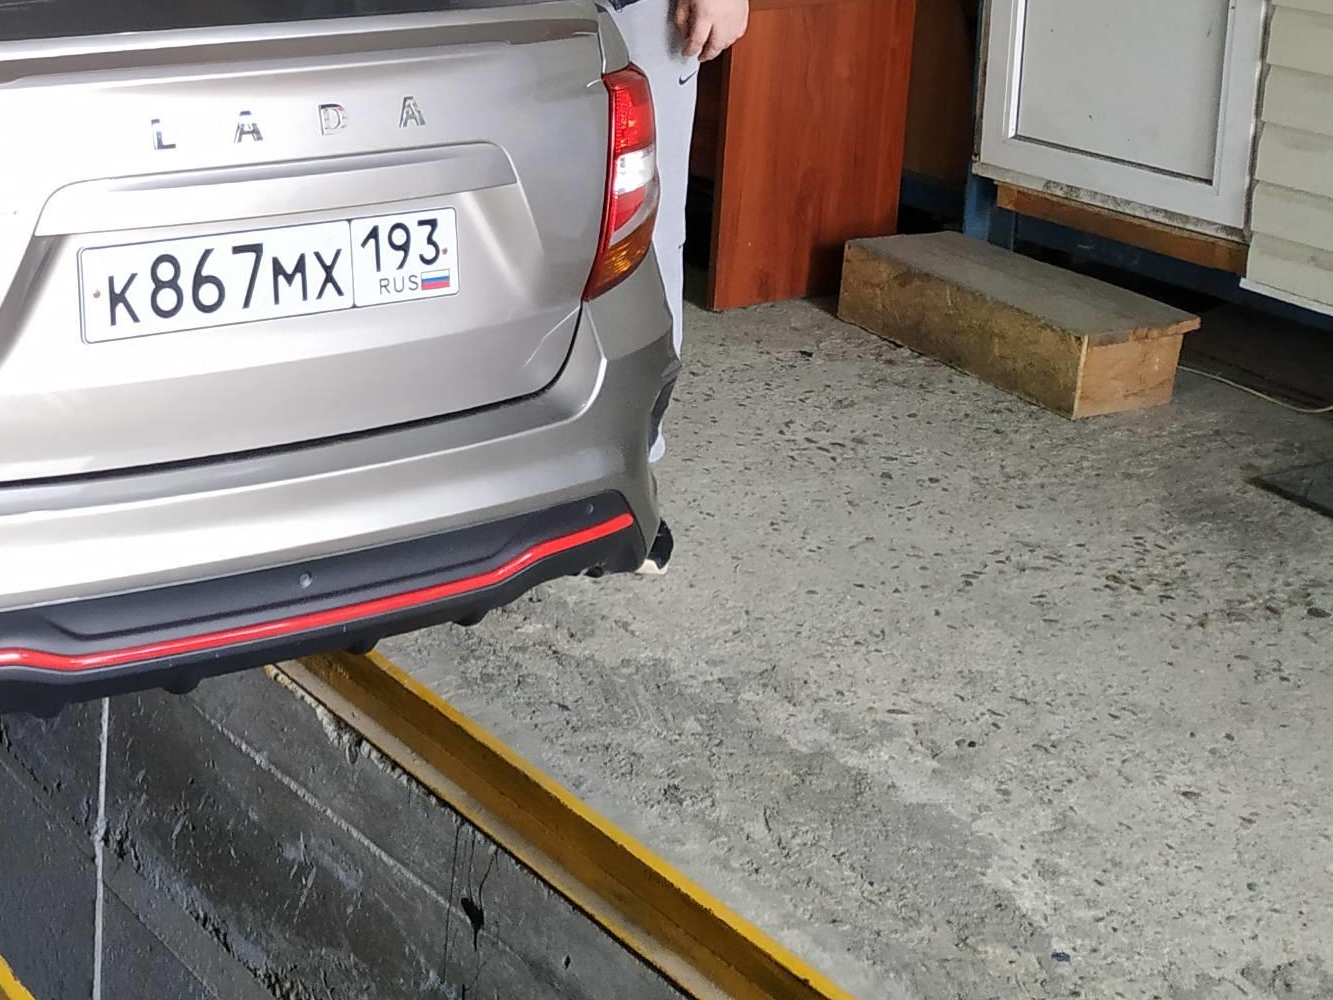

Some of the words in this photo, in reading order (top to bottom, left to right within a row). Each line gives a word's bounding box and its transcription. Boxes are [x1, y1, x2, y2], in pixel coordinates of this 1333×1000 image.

[150, 96, 426, 150] LADA
[108, 243, 344, 326] К867МХ
[360, 218, 441, 272] 193
[378, 274, 420, 295] RUS
